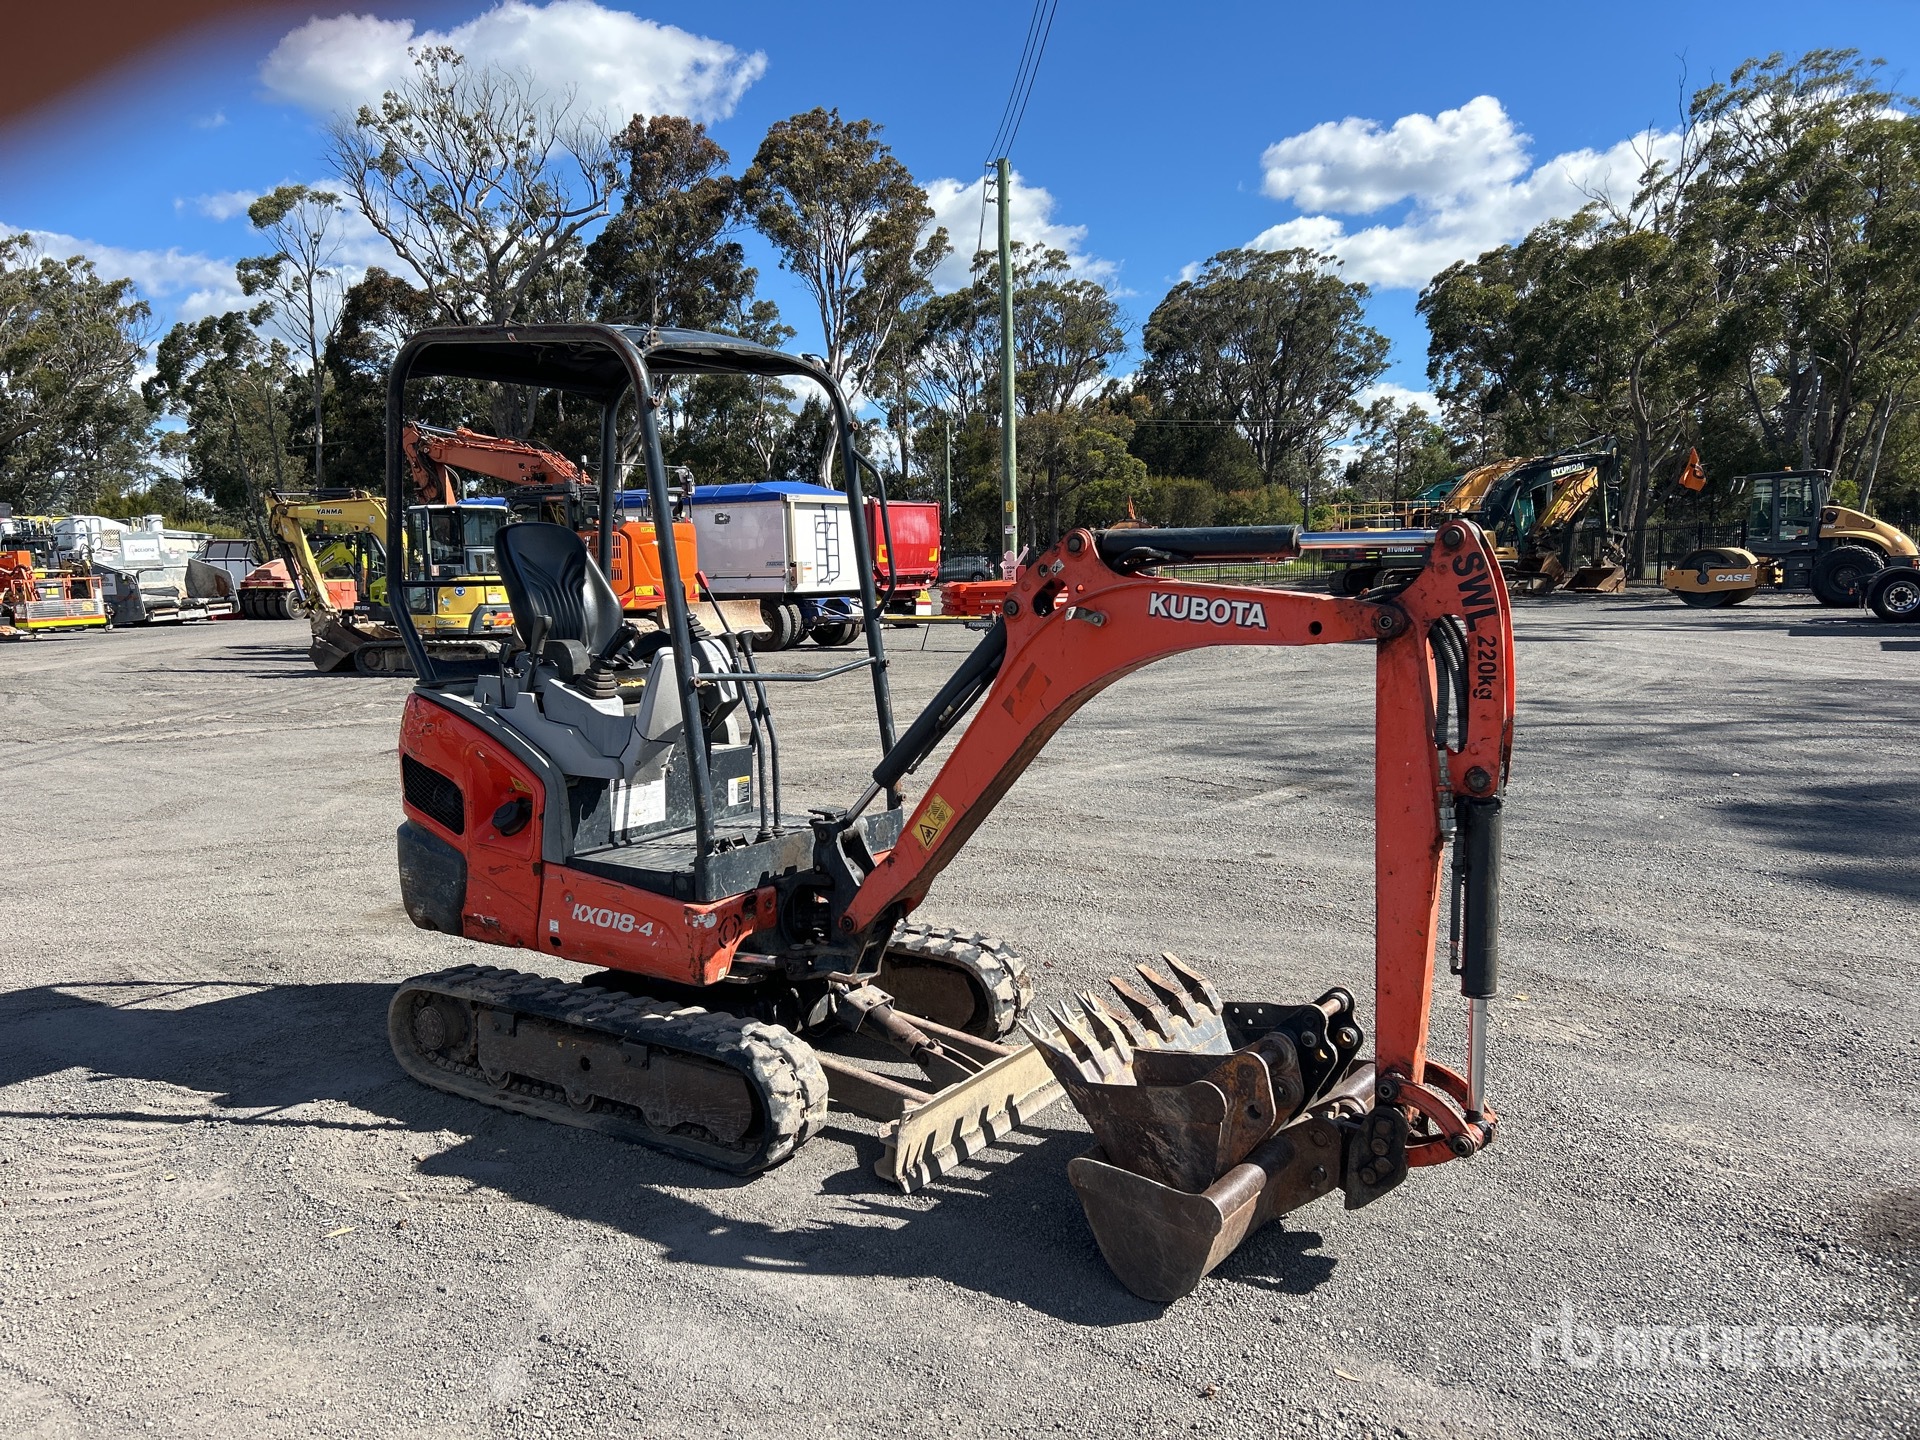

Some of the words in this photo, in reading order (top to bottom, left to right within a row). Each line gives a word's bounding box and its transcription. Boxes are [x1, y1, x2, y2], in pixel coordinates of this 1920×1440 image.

[1551, 461, 1585, 477] HYUNDAI
[1453, 551, 1498, 633] SWL
[1715, 573, 1751, 582] CASE
[1148, 591, 1268, 630] KUBOTA
[1472, 635, 1498, 700] 220kg
[572, 903, 654, 937] KX018-4
